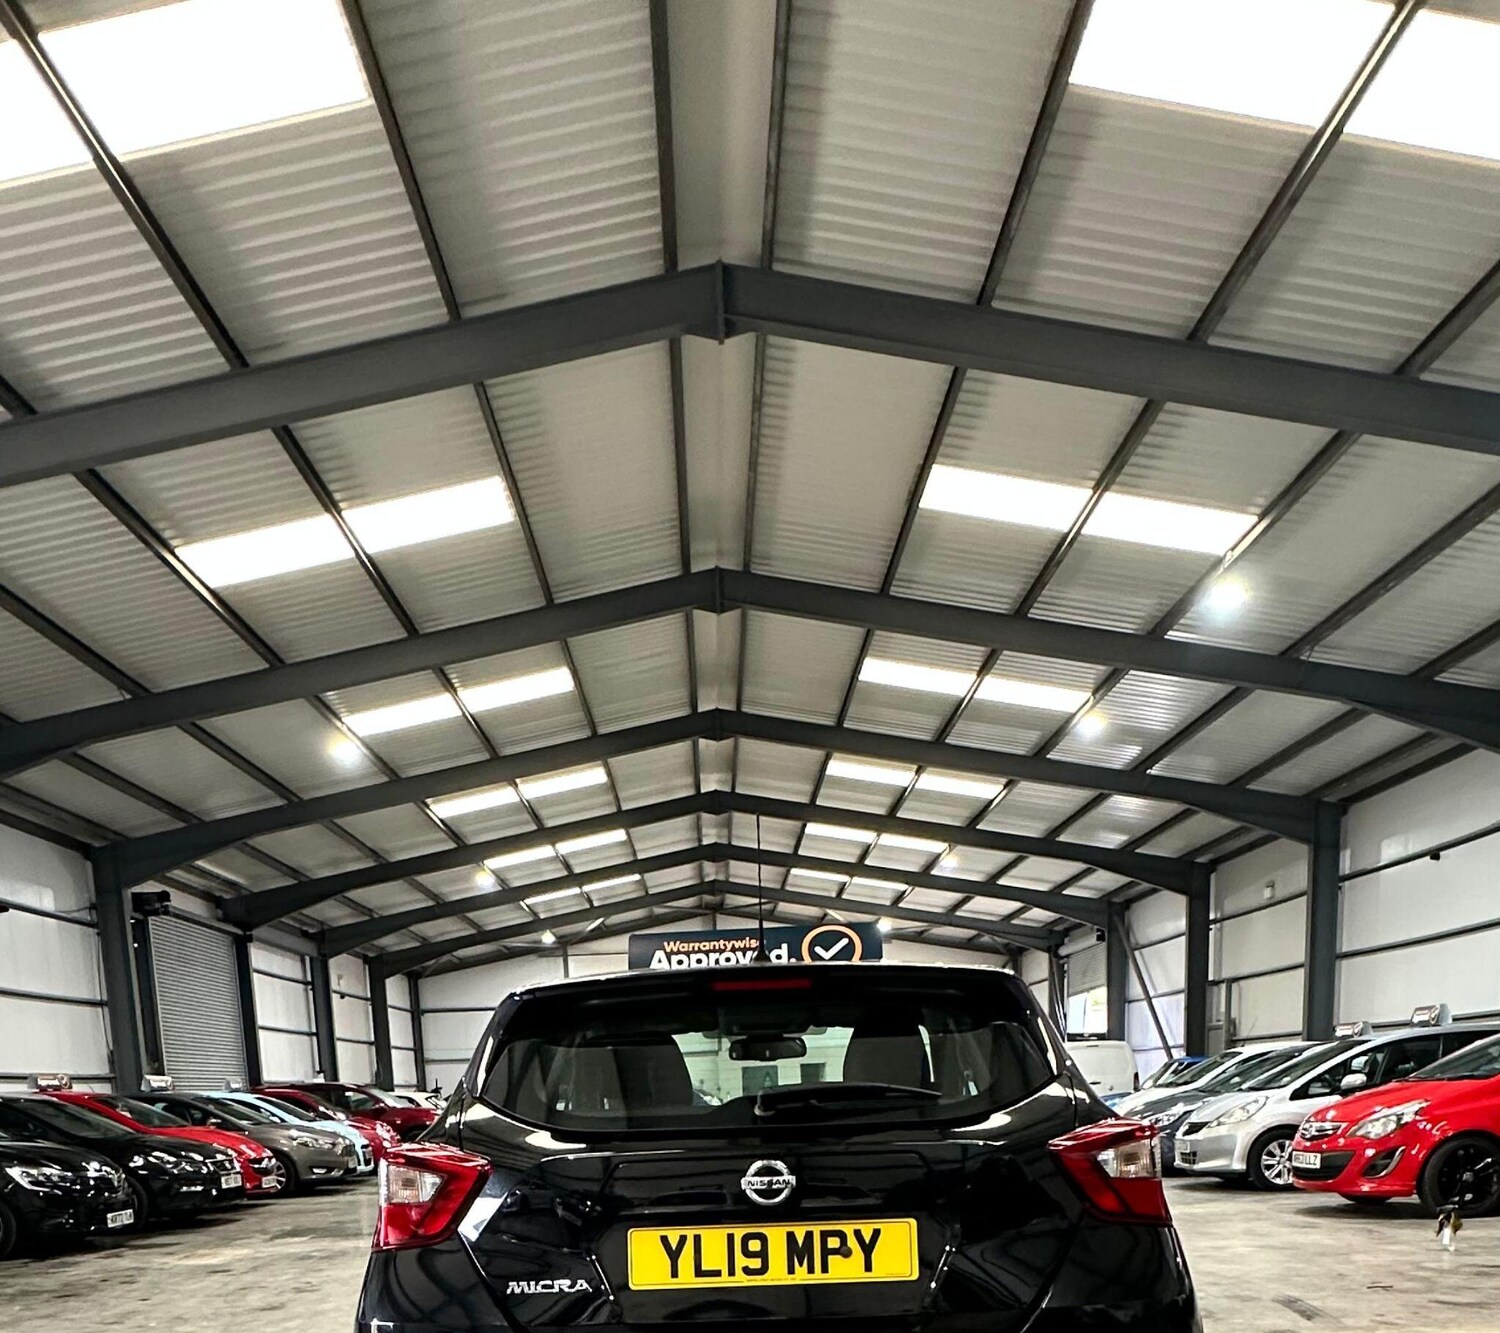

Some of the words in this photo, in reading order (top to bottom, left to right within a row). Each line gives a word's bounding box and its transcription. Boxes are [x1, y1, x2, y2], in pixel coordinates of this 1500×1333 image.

[663, 936, 766, 952] Warrantywis
[649, 943, 797, 970] Approvd.
[747, 1178, 790, 1187] NISSAN
[659, 1231, 769, 1279] YL19
[785, 1227, 881, 1275] MPY
[506, 1278, 593, 1295] MICRA
